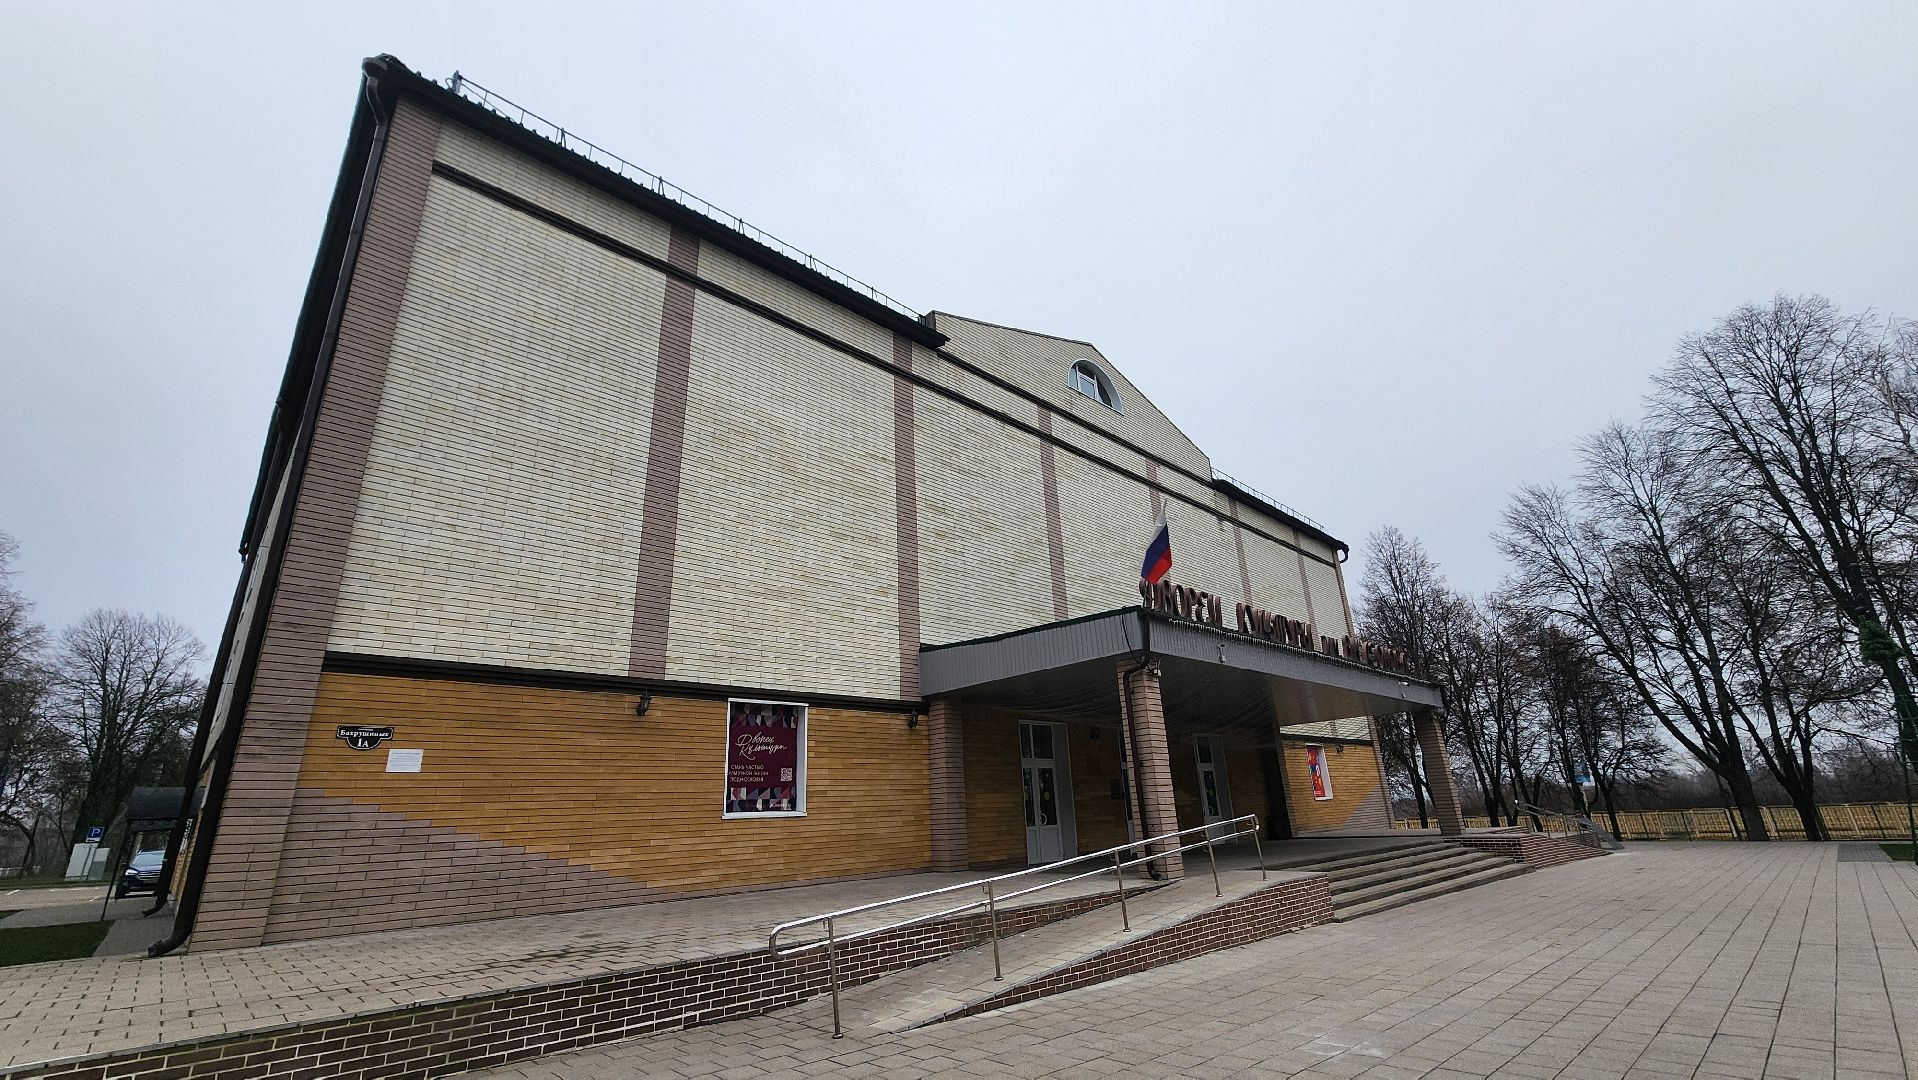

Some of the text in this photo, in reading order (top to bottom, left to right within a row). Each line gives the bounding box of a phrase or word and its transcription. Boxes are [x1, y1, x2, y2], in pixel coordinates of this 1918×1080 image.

[1139, 579, 1222, 625] ДВОРЕЦ
[340, 729, 389, 738] Бахрушиных
[91, 828, 101, 837] P
